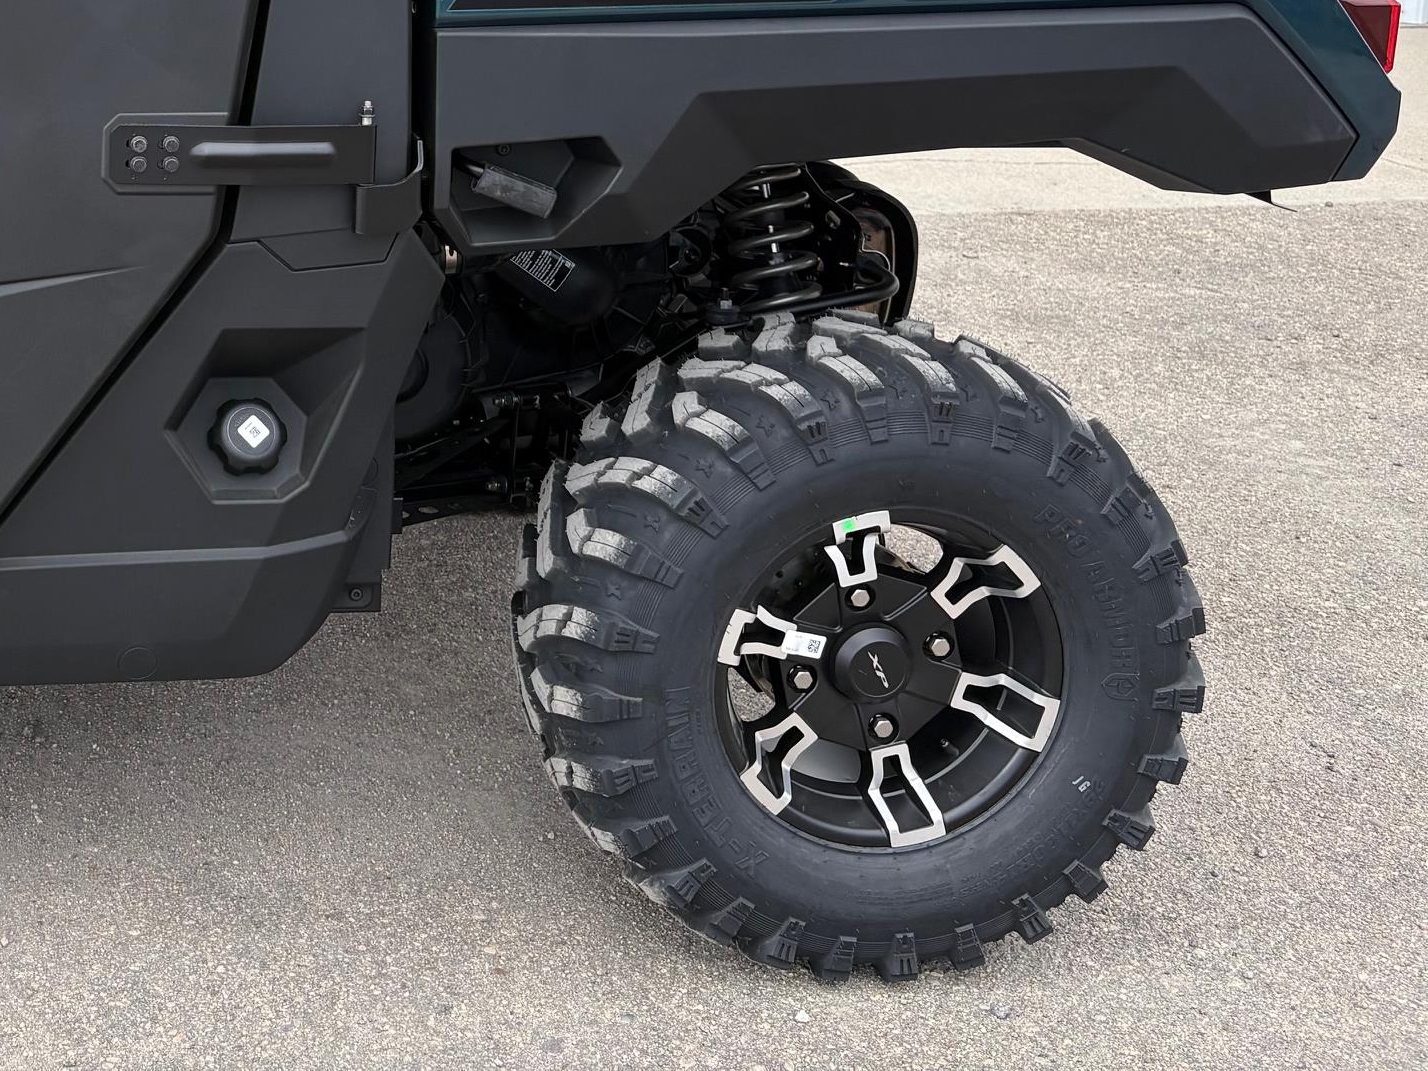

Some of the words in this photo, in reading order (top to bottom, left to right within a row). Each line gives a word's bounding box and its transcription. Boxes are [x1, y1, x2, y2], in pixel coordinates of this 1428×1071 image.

[1034, 504, 1091, 558] PRO
[868, 651, 889, 689] XP
[665, 686, 770, 876] X-TERRAIN
